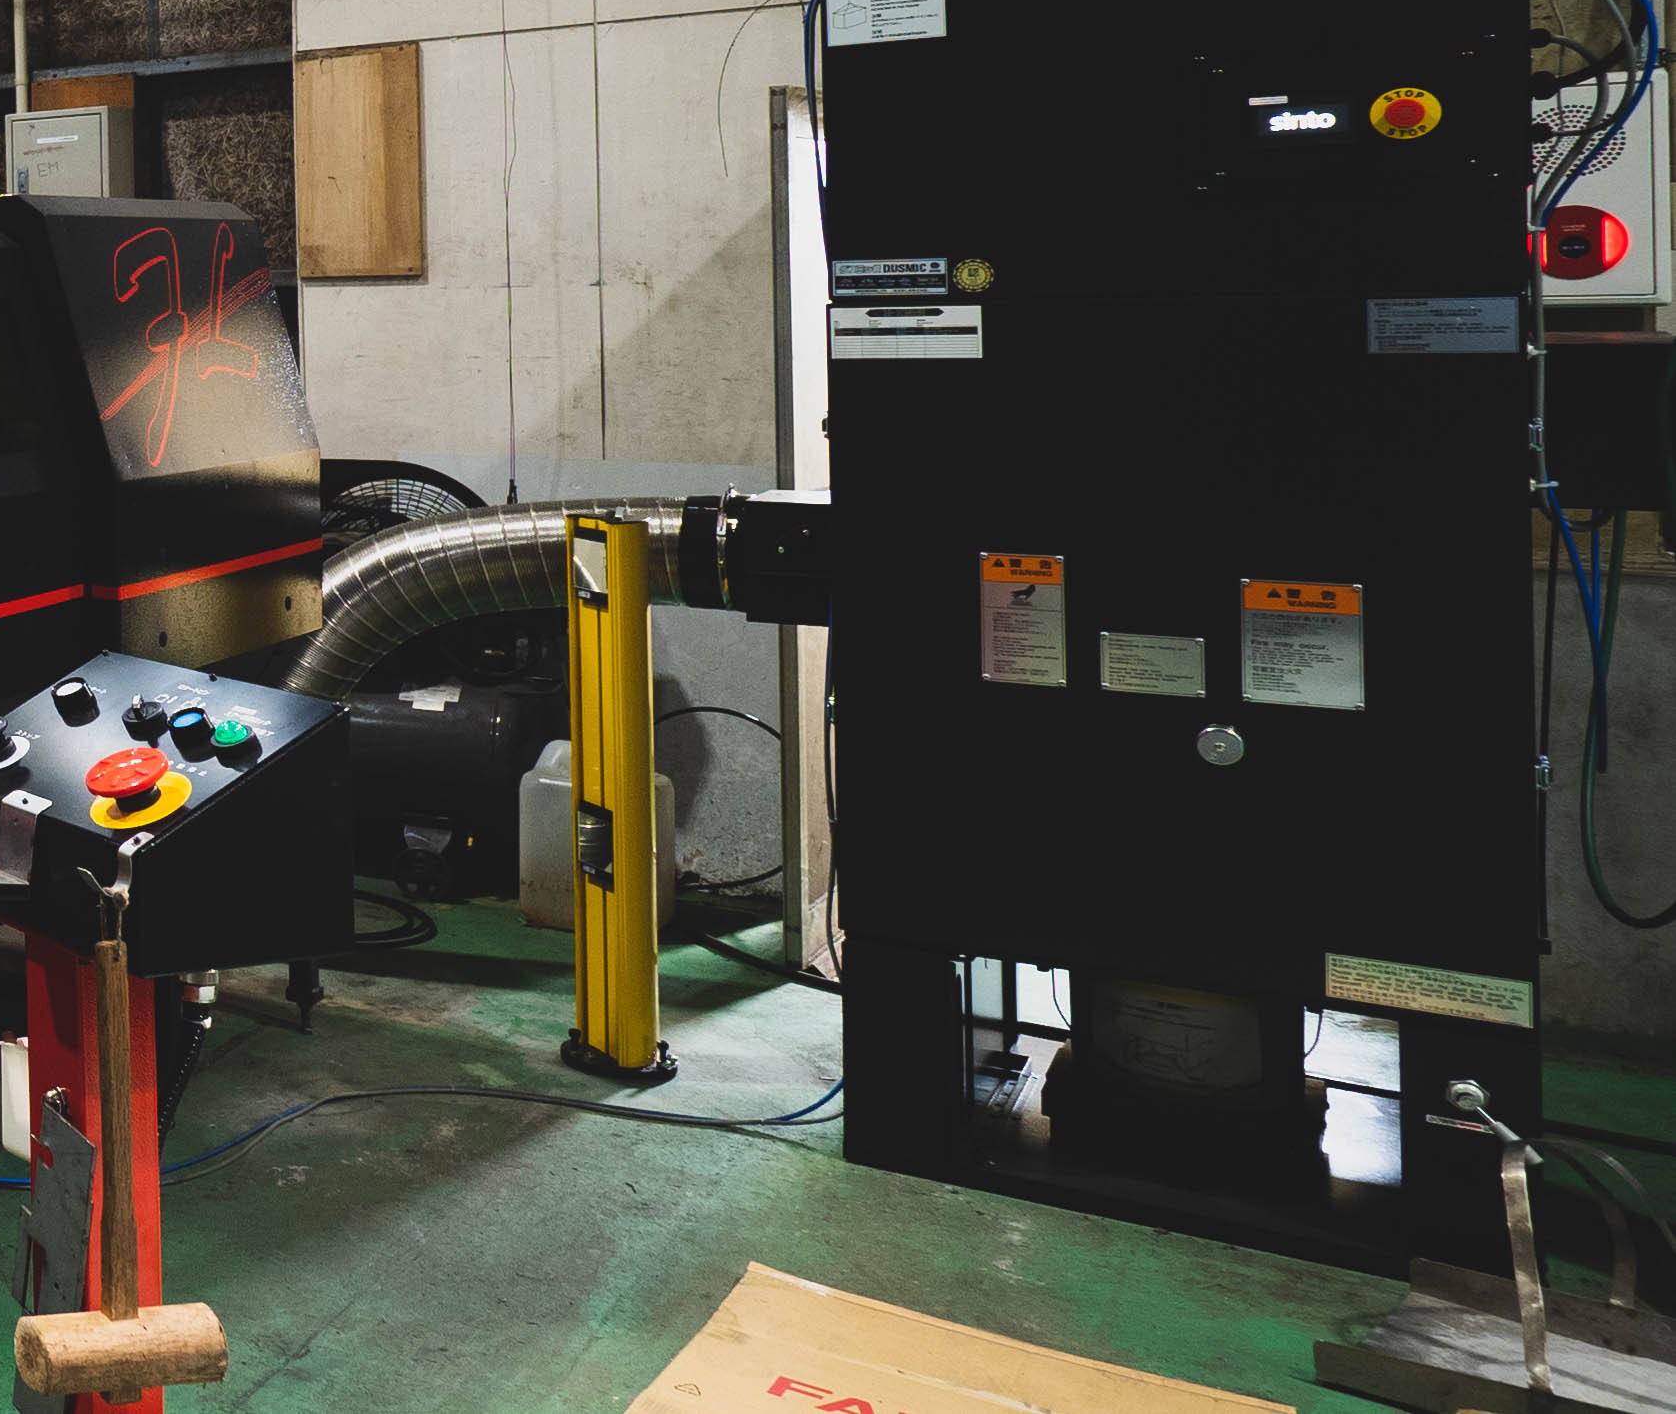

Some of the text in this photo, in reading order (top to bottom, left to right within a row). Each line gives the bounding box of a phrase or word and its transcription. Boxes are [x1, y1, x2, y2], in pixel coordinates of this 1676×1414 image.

[1383, 88, 1425, 103] STOP
[1268, 110, 1337, 132] sinto
[1387, 123, 1428, 138] STOP
